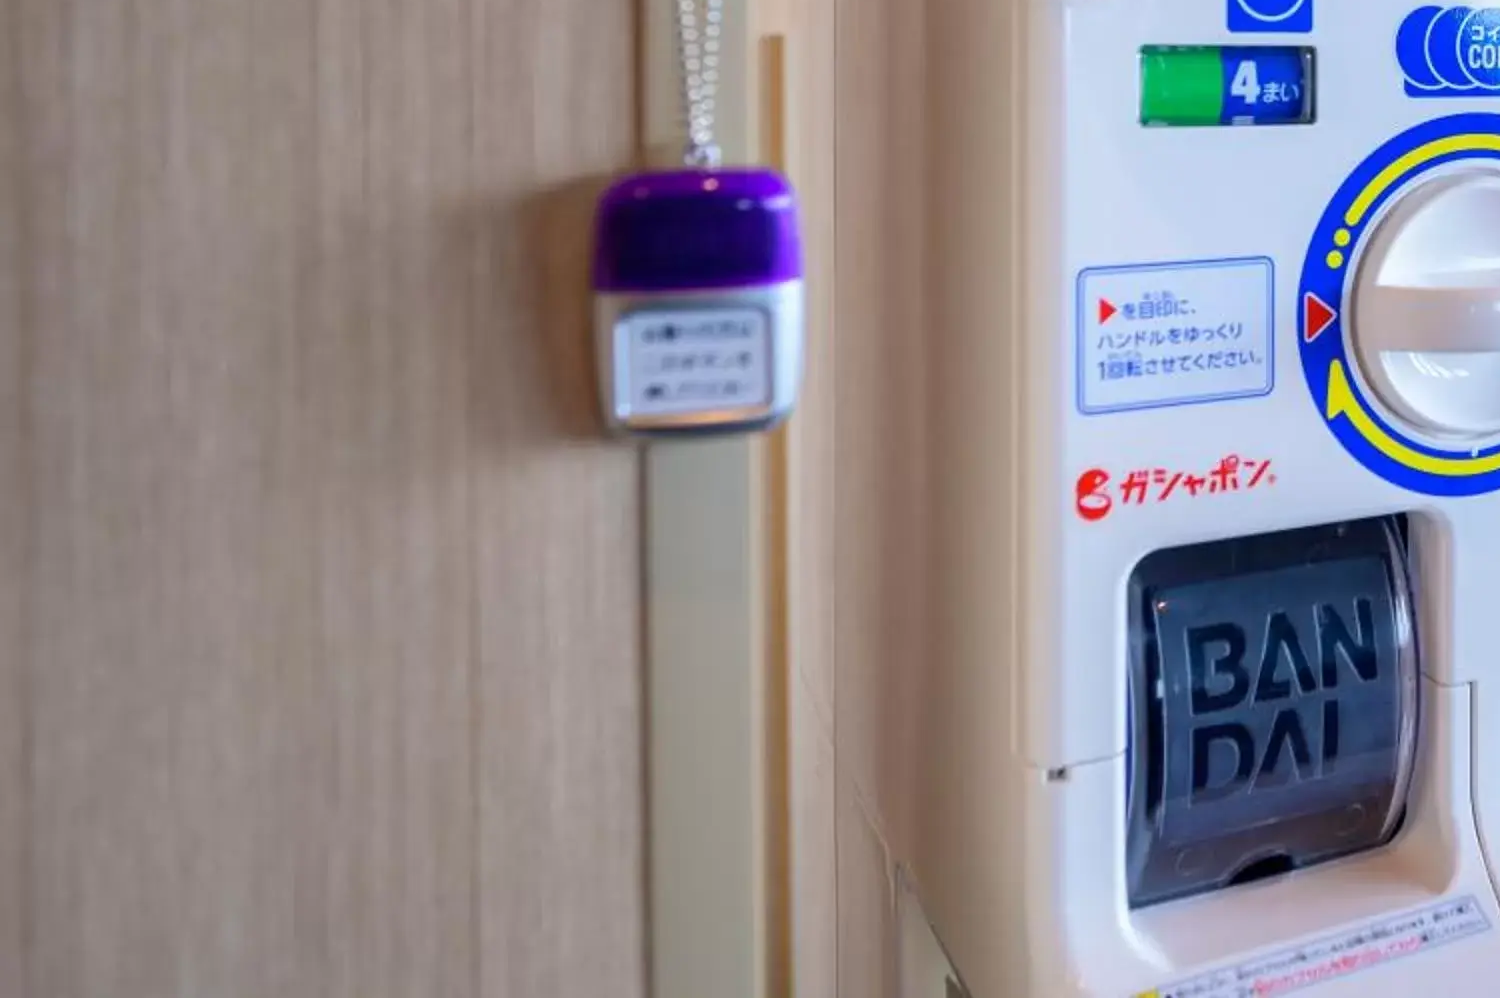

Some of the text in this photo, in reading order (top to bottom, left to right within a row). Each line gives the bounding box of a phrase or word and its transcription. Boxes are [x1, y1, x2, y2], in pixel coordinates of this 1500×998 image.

[1097, 322, 1243, 350] ハンドルをゆっくり
[1120, 454, 1271, 505] ガシャポン
[1184, 598, 1378, 717] BAN
[1190, 699, 1340, 802] DAI
